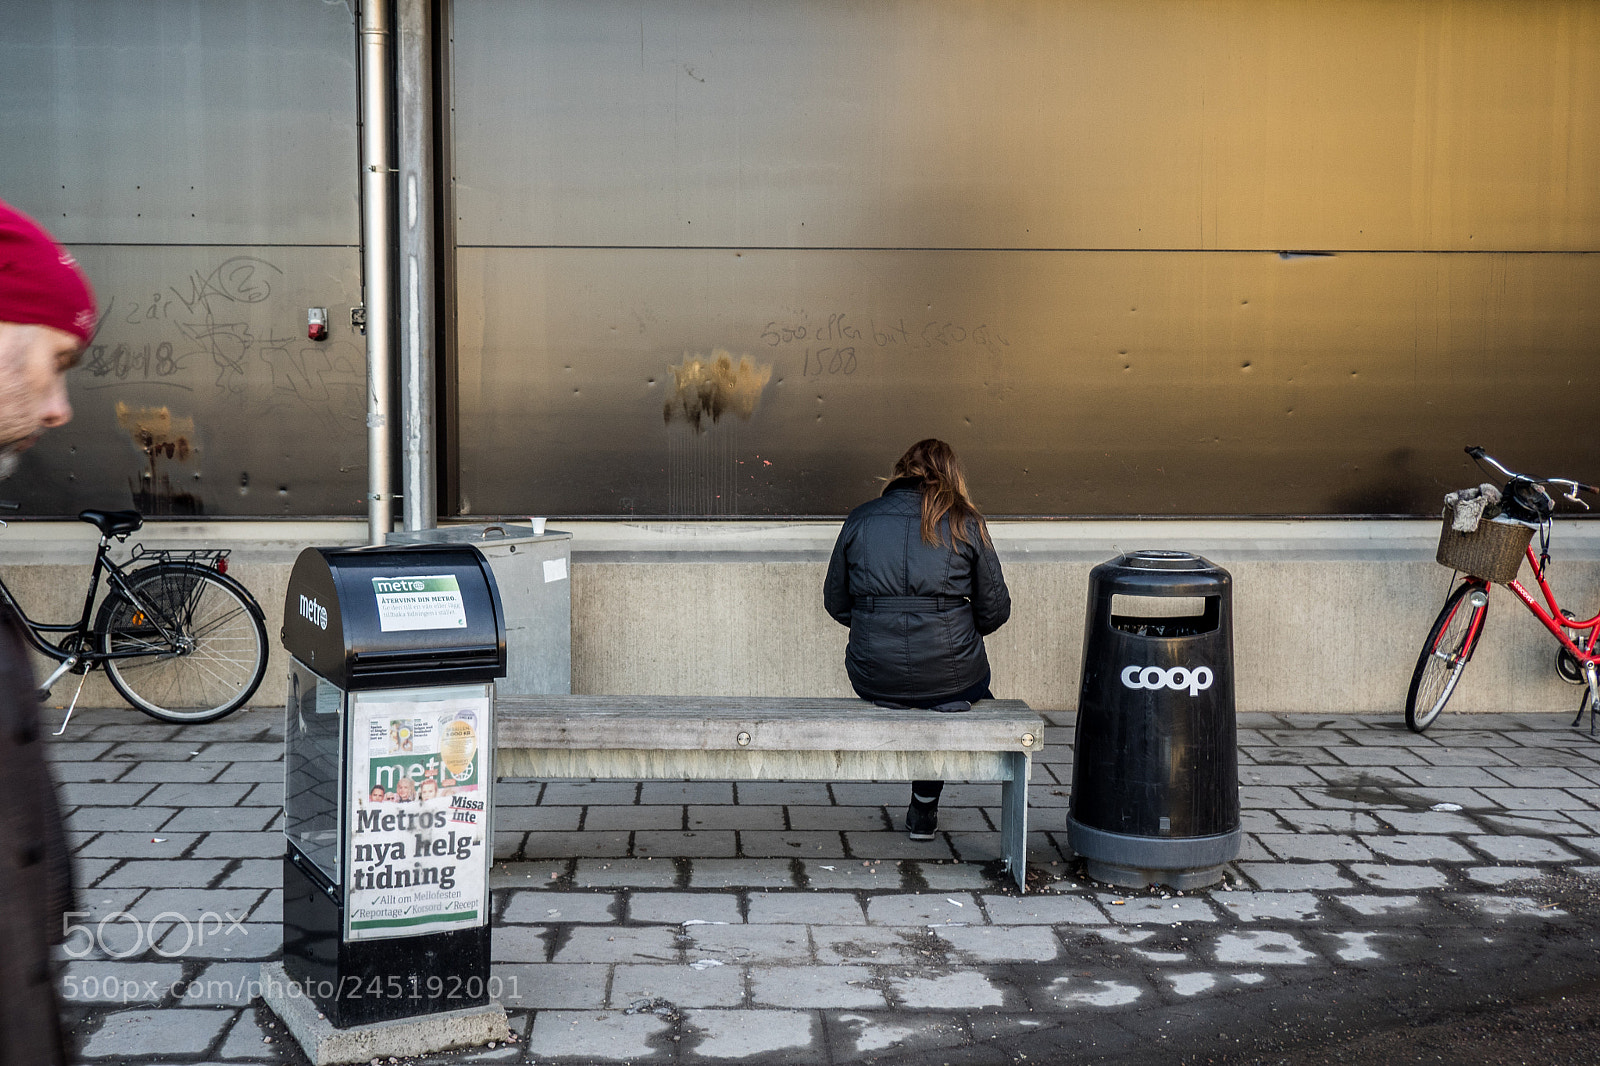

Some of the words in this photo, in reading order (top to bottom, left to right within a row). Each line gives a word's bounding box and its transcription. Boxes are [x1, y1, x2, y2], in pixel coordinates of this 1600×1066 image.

[377, 580, 425, 592] metro
[381, 596, 417, 604] ÅTERVINN
[299, 594, 328, 631] metro
[1120, 665, 1214, 697] coop
[450, 796, 484, 811] Missa
[355, 809, 447, 833] Metros
[452, 809, 476, 823] inte
[354, 840, 406, 867] nya
[413, 831, 481, 860] helg-
[354, 862, 456, 890] tidning
[380, 895, 396, 905] Allt
[414, 890, 461, 901] Mellofesten
[360, 908, 403, 919] Reportage
[412, 903, 442, 914] Korsord
[454, 899, 479, 910] Recept
